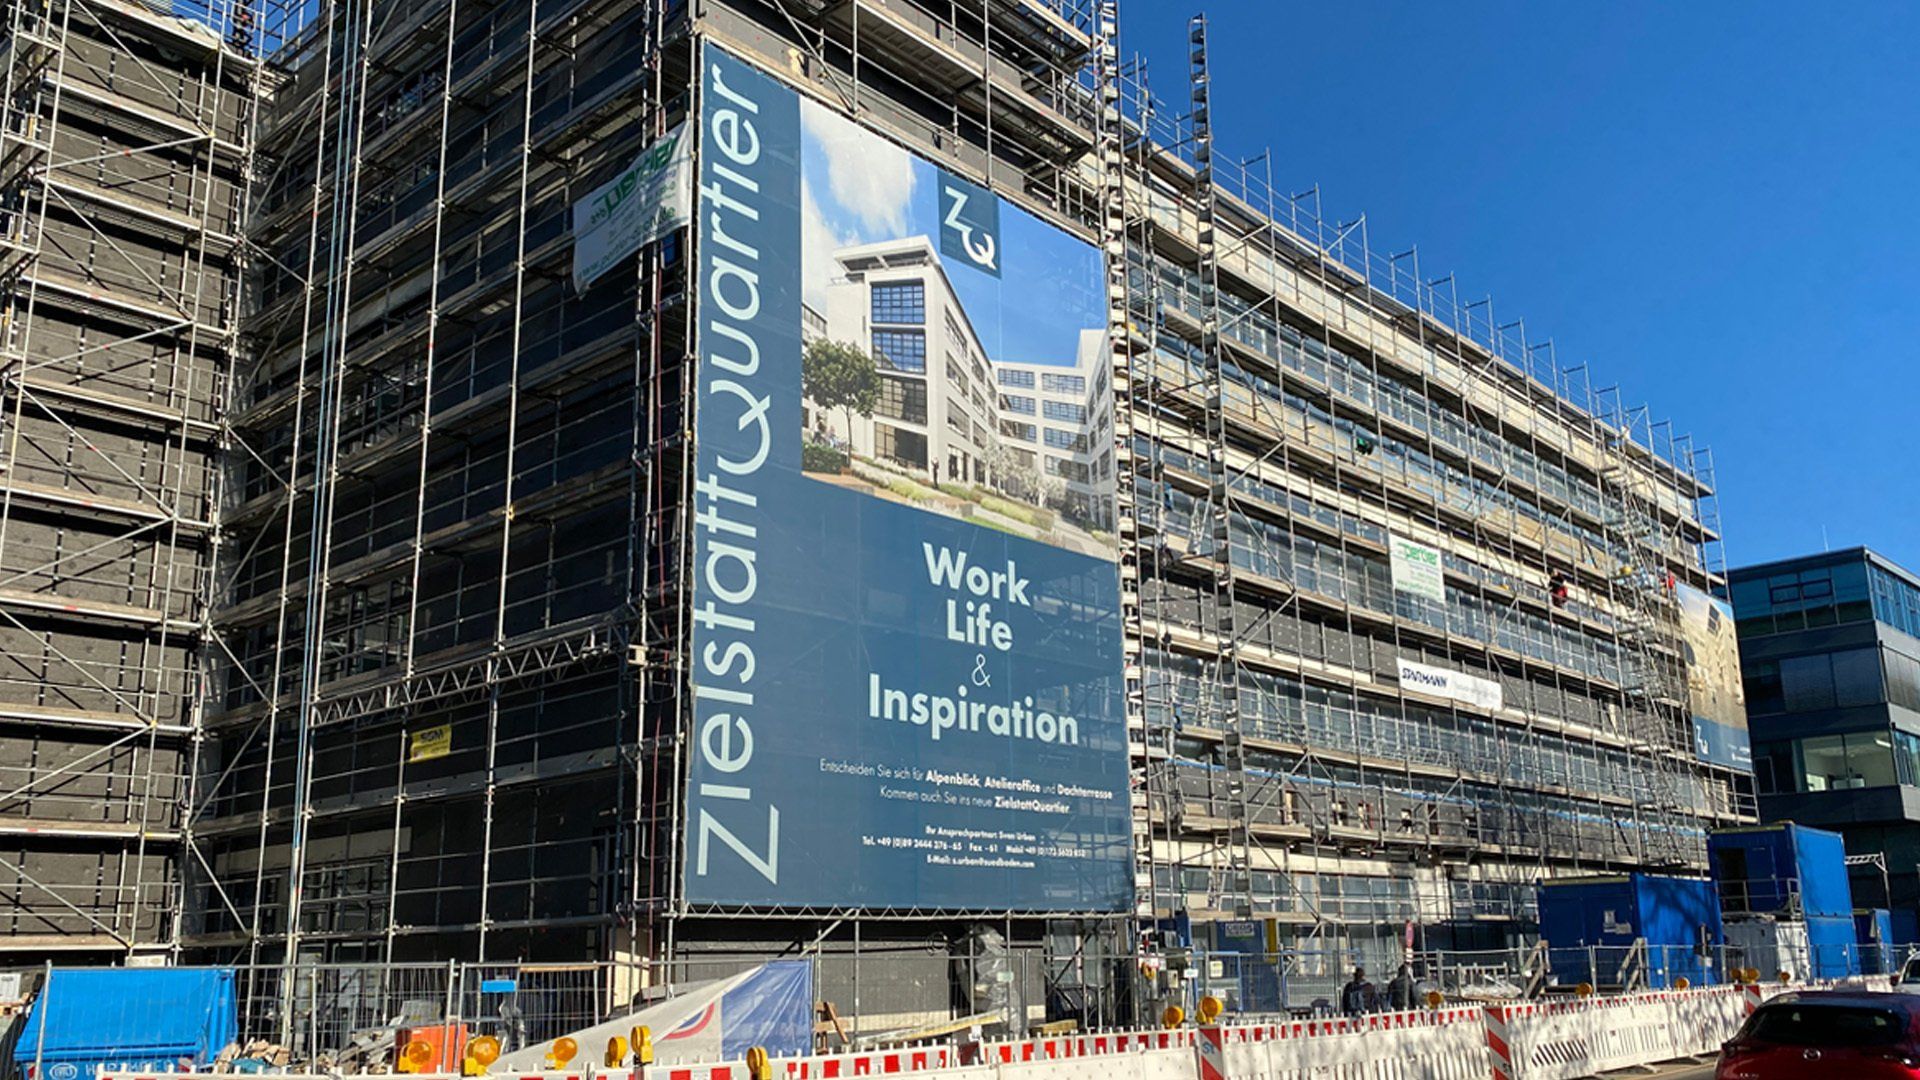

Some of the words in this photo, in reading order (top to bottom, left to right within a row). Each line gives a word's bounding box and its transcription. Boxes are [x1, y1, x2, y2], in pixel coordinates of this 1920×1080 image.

[944, 185, 997, 271] ZQ
[693, 63, 779, 886] ZielstattQuartier
[922, 541, 1031, 607] Work
[947, 599, 1013, 651] Life
[971, 653, 991, 688] &
[869, 673, 1079, 745] Inspiration
[819, 758, 876, 777] Entscheiden
[877, 763, 892, 778] Sie
[893, 765, 910, 780] sich
[912, 766, 924, 781] für
[925, 768, 982, 788] Alpenblick,
[984, 775, 1041, 794] Atelieroffice
[1042, 782, 1056, 795] und
[1057, 783, 1113, 800] Dachterrasse
[879, 785, 919, 801] Kommen
[920, 788, 943, 803] auch
[943, 790, 958, 806] Sie
[958, 793, 971, 807] ins
[971, 795, 993, 808] neue
[862, 835, 876, 846] Tel.
[969, 842, 983, 852] Fax
